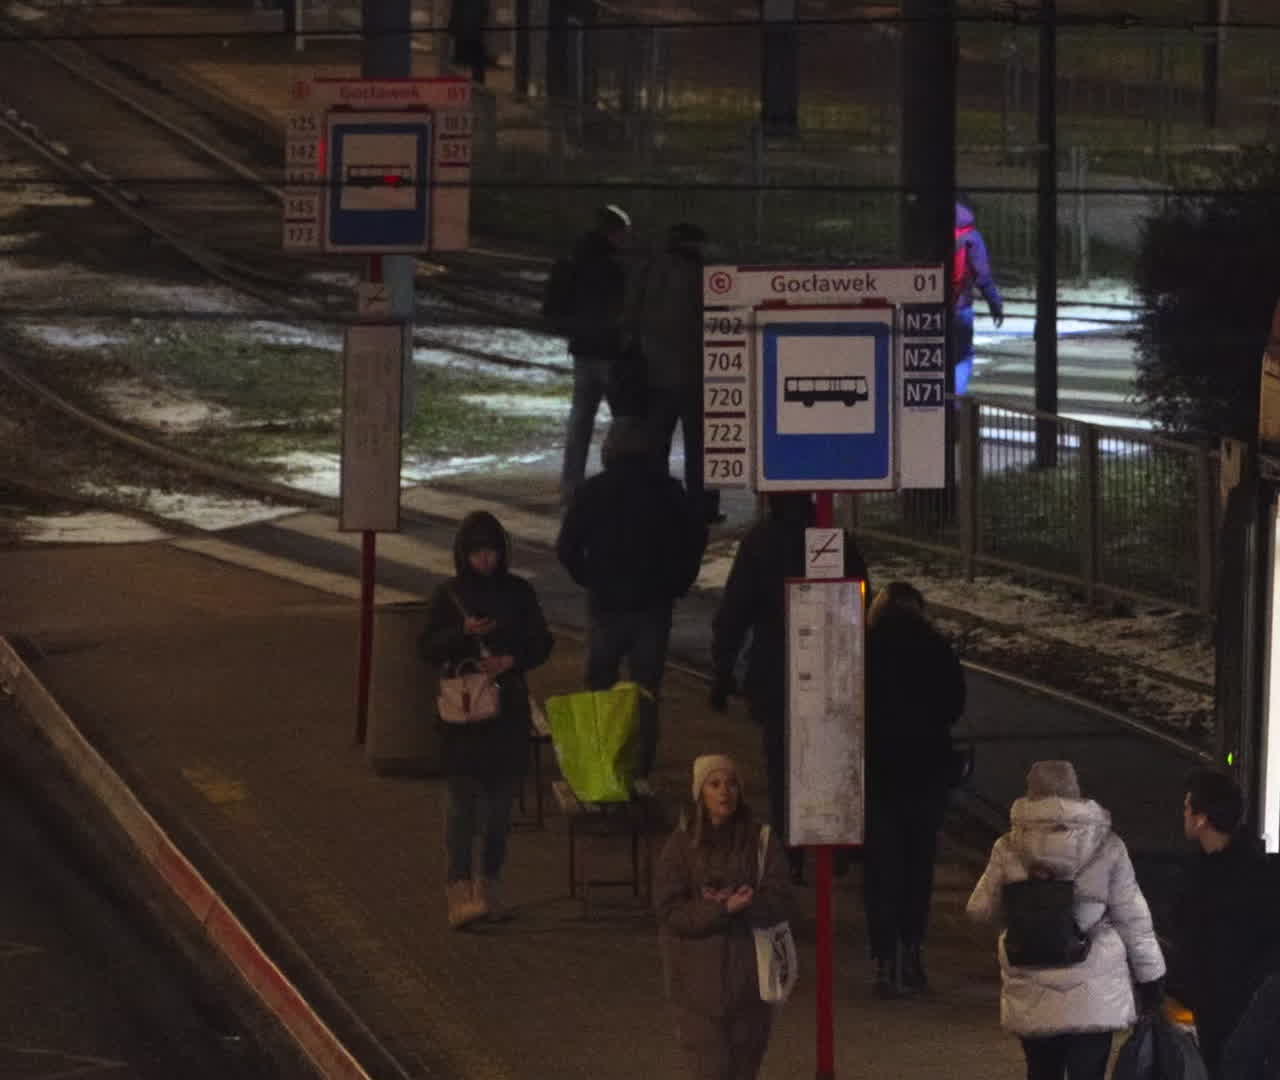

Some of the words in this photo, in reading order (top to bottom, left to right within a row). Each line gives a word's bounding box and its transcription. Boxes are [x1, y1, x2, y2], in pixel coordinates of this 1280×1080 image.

[770, 273, 877, 294] Gocławek
[914, 275, 937, 292] 01
[708, 316, 743, 335] 702
[906, 313, 942, 330] N21
[708, 354, 743, 372] 704
[904, 349, 943, 367] N24
[709, 389, 743, 407] 720
[906, 383, 942, 402] N71
[709, 424, 743, 442] 722
[709, 460, 744, 478] 730
